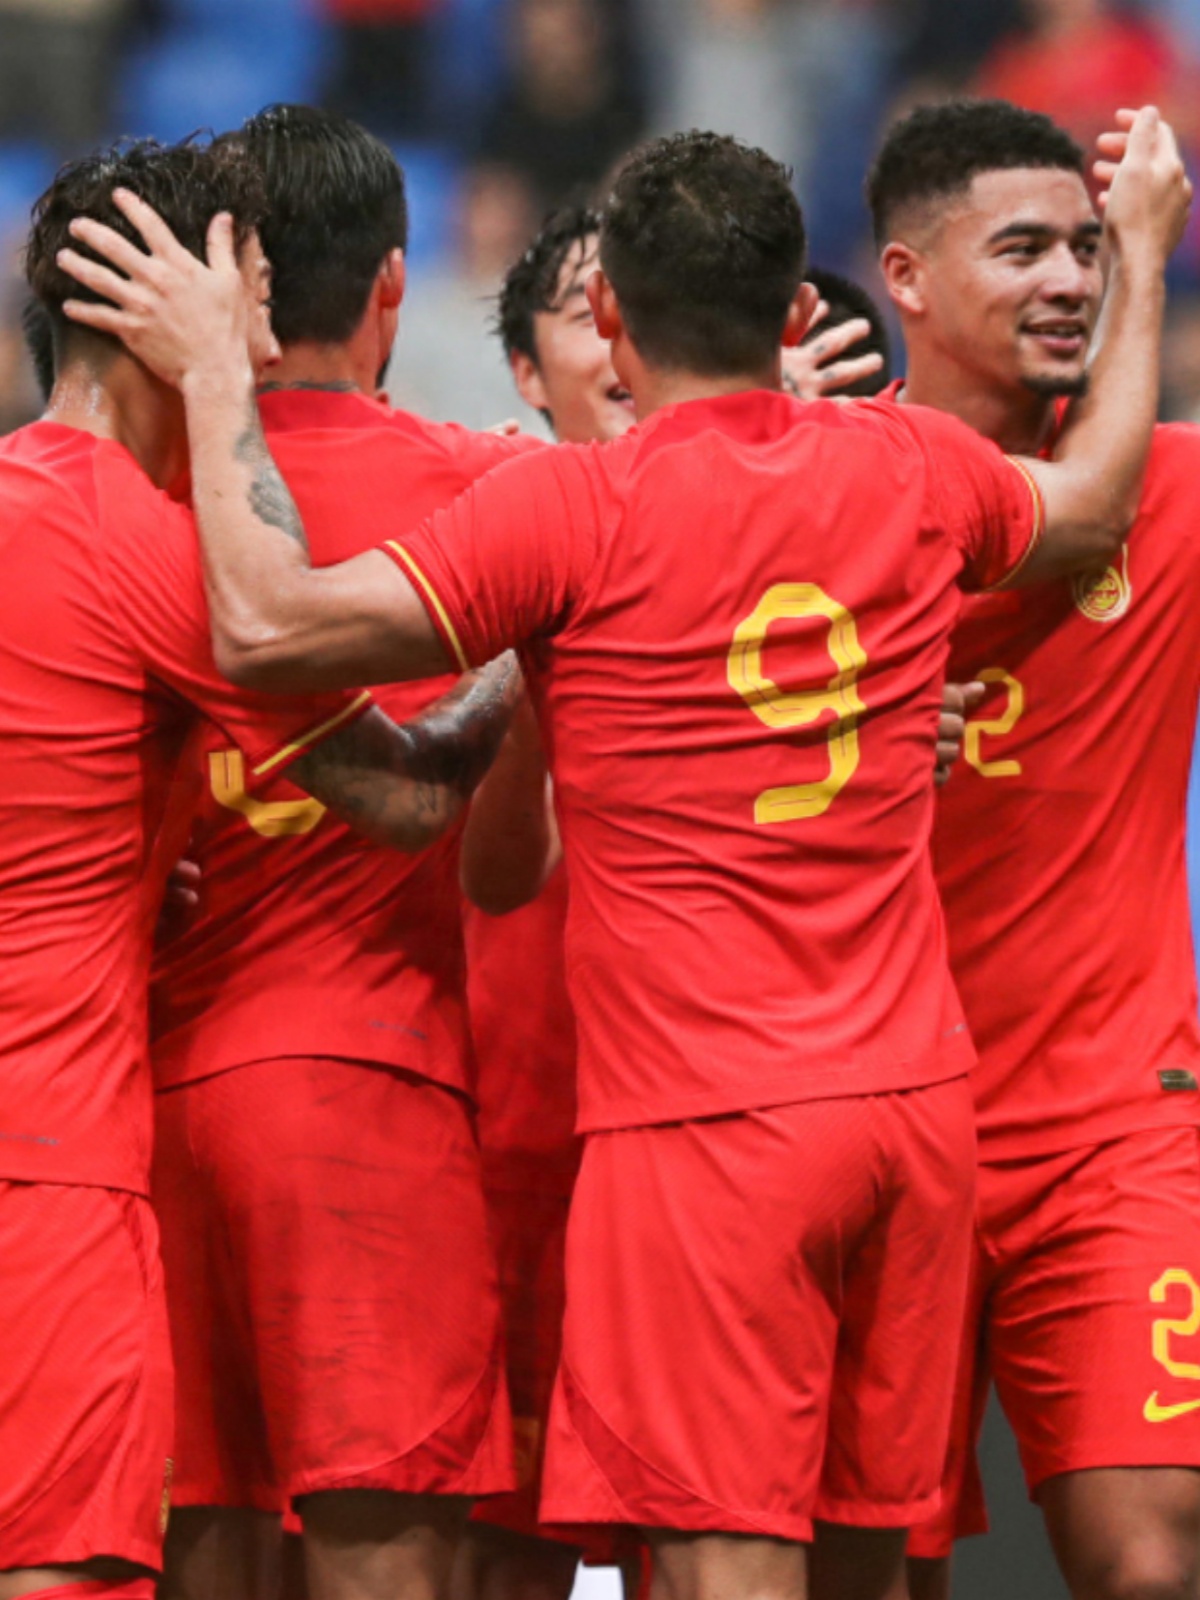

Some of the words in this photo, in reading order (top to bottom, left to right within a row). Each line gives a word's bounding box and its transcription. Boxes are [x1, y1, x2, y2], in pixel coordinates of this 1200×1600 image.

[727, 582, 867, 825] 9
[964, 667, 1023, 778] 2
[1149, 1268, 1200, 1380] 2
